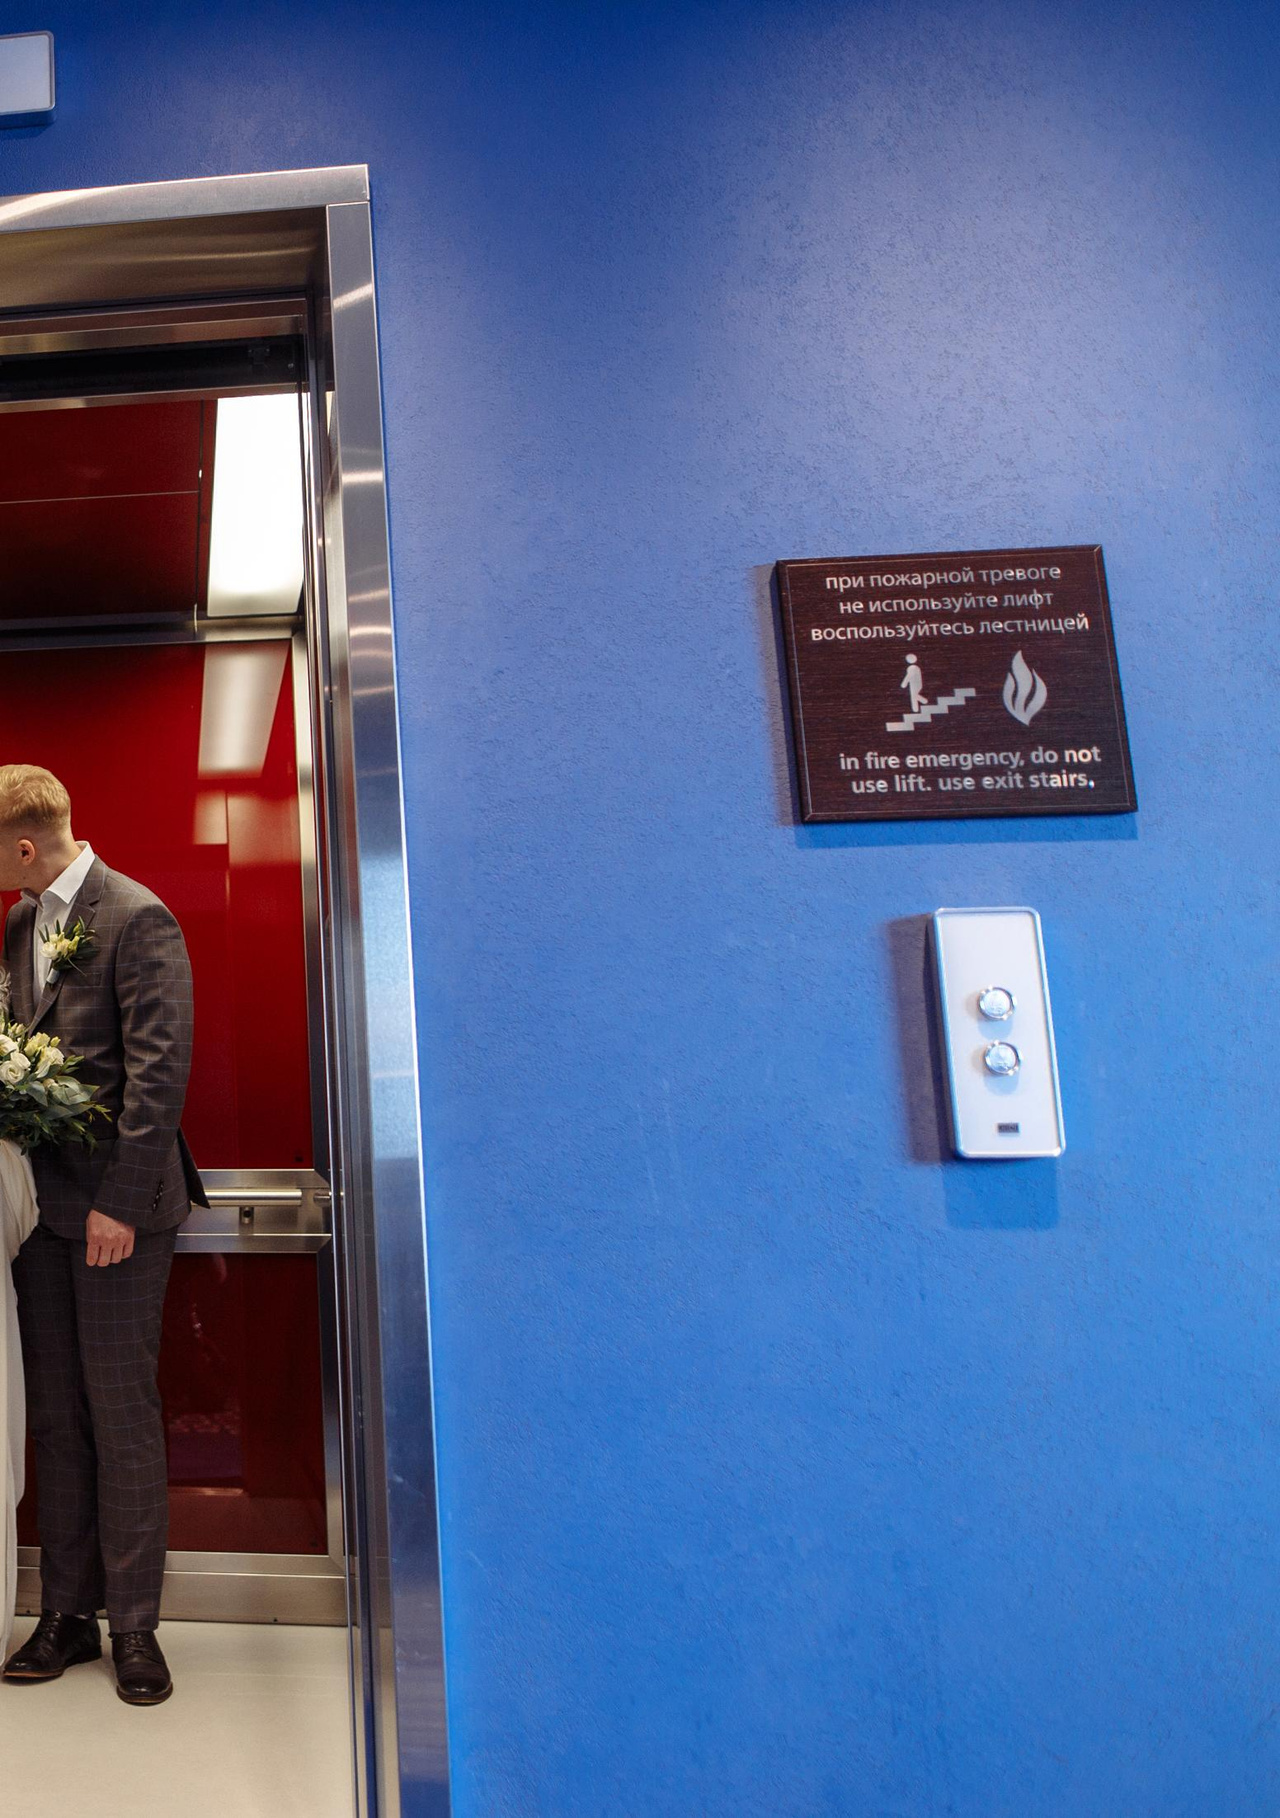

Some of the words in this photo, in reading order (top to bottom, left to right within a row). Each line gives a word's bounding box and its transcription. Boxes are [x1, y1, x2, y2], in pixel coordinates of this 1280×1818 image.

[826, 576, 865, 593] при
[870, 567, 975, 589] пожарной
[979, 566, 1061, 585] тревоге
[839, 600, 864, 614] не
[869, 593, 998, 614] используйте
[1003, 589, 1054, 610] лифт
[811, 621, 974, 642] воспользуйтесь
[979, 613, 1089, 634] лестницей
[839, 754, 860, 770] in
[865, 753, 900, 769] fire
[1030, 747, 1059, 764] do
[1064, 746, 1101, 763] not
[852, 779, 888, 794] use
[894, 775, 932, 792] lift.
[939, 776, 975, 791] use
[982, 773, 1024, 790] exit
